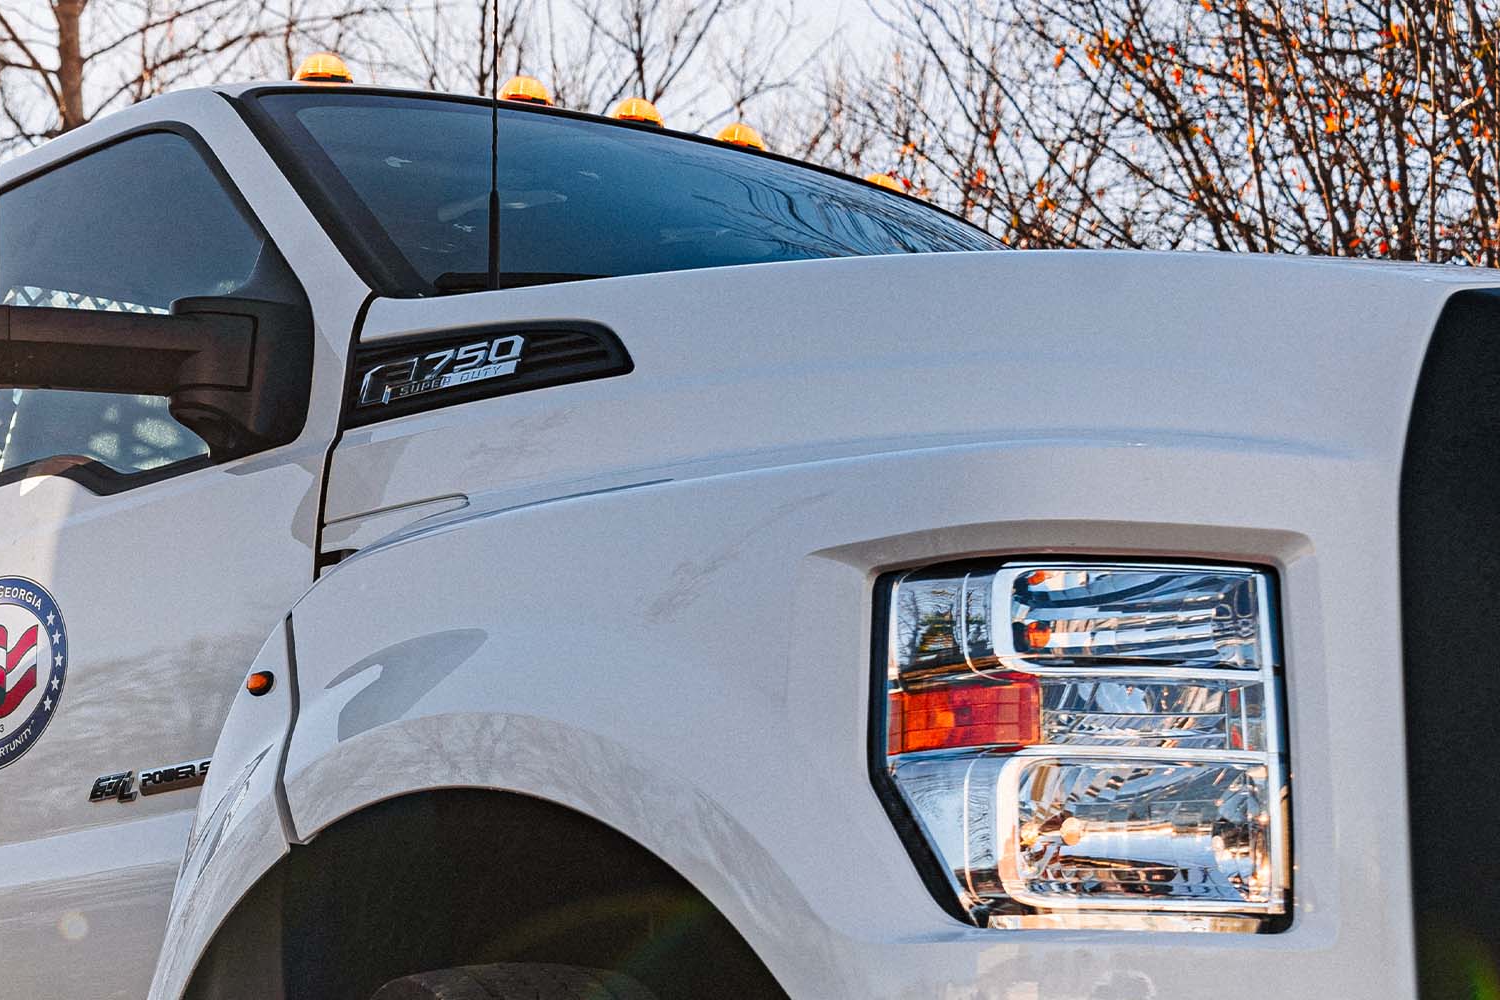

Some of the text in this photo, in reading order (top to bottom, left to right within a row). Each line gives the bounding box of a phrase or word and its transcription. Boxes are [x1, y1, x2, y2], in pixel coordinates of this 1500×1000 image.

[399, 364, 503, 397] SUPER DUTY
[141, 763, 197, 788] POWER
